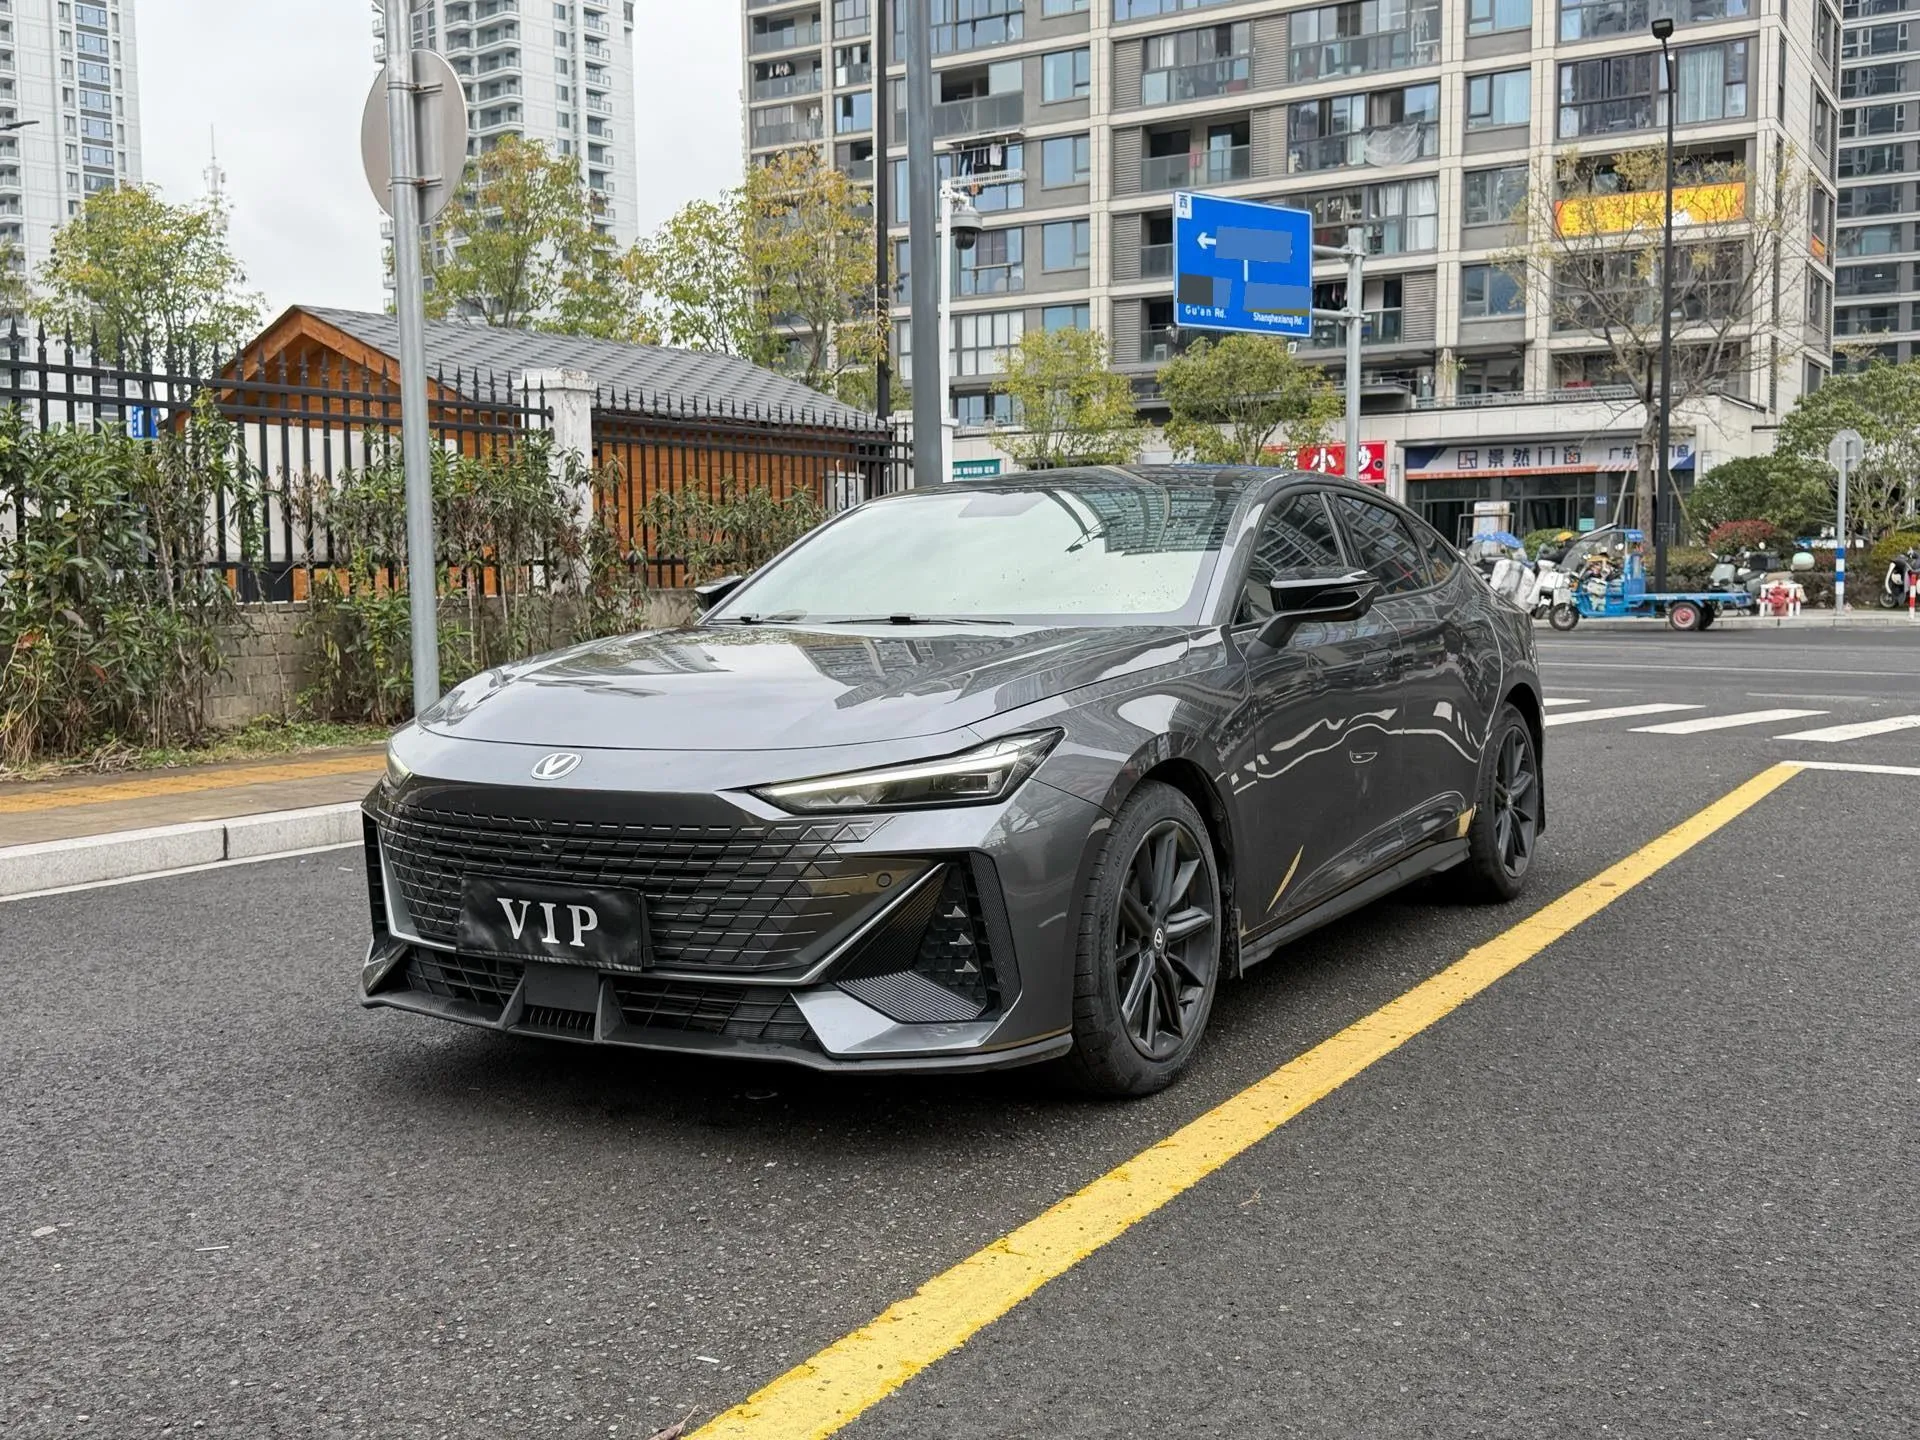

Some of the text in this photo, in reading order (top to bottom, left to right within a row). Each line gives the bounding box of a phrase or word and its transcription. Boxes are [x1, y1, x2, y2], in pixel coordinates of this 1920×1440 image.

[1185, 305, 1227, 318] Gu'an Rd.
[1253, 312, 1304, 326] Shanghexiang Rd.
[1488, 444, 1582, 468] 景然门窗
[496, 897, 599, 947] VIP
